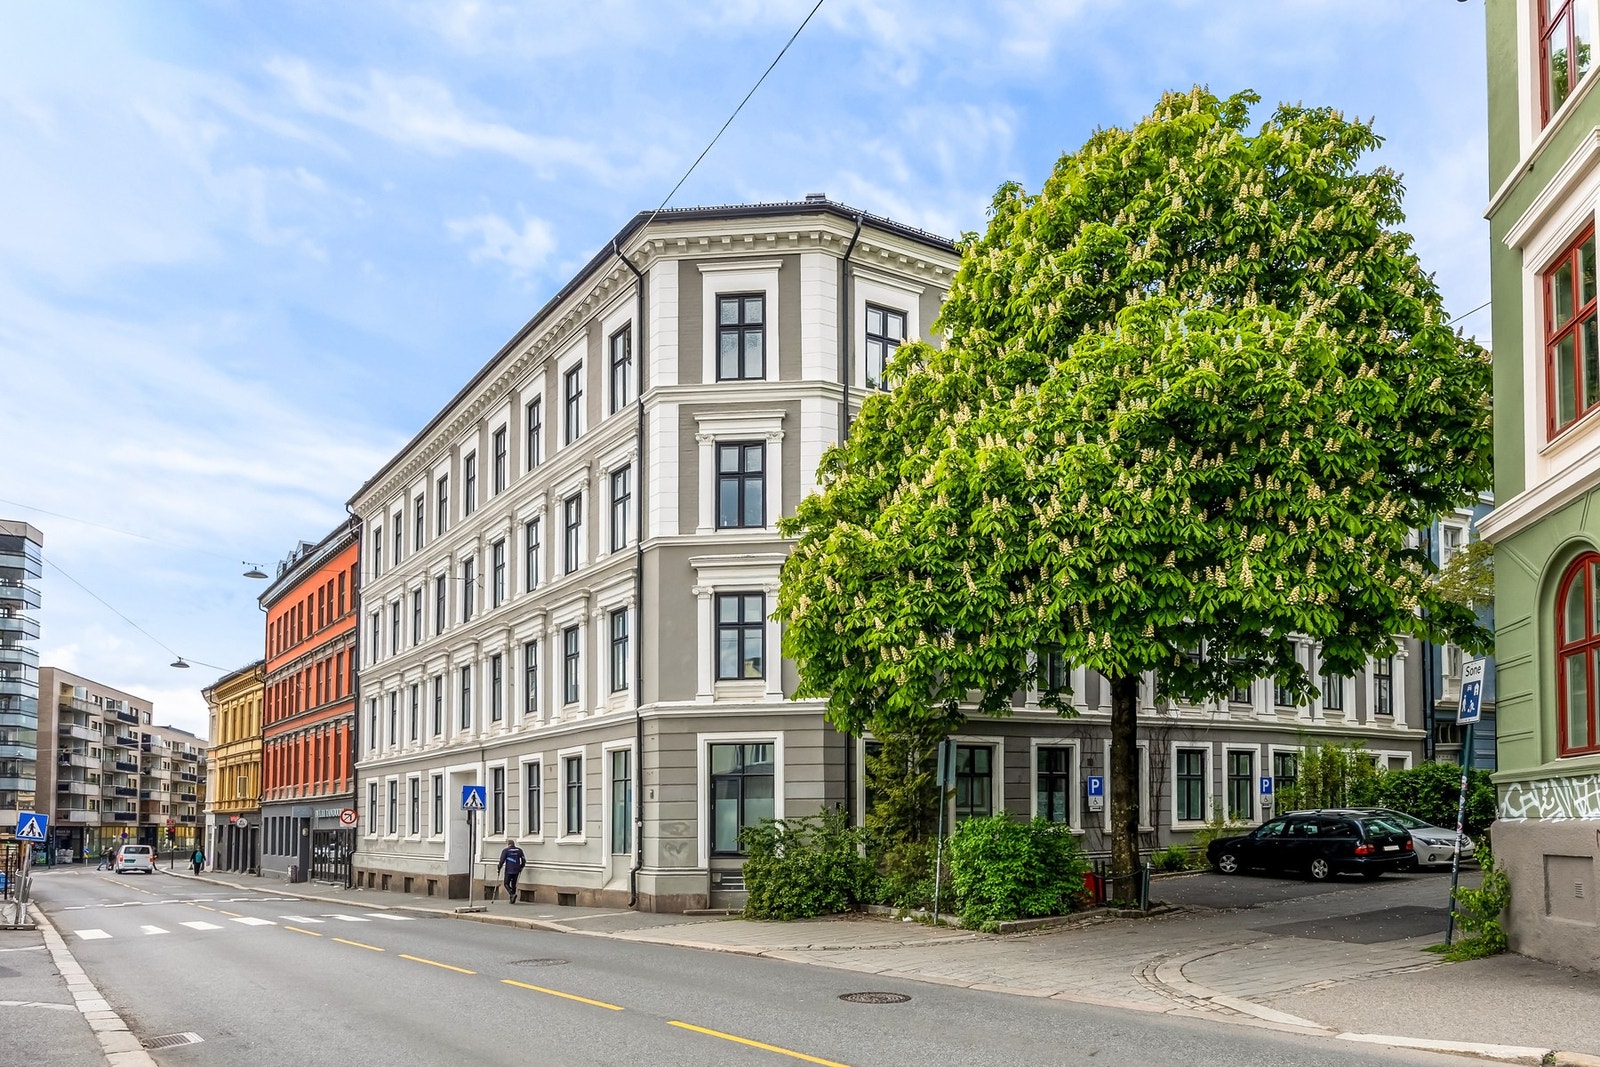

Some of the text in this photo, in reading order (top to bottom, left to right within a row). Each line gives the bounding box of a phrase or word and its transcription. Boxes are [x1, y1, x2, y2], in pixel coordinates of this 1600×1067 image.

[1465, 665, 1482, 677] Sone
[1091, 779, 1100, 794] P
[1262, 779, 1270, 793] P
